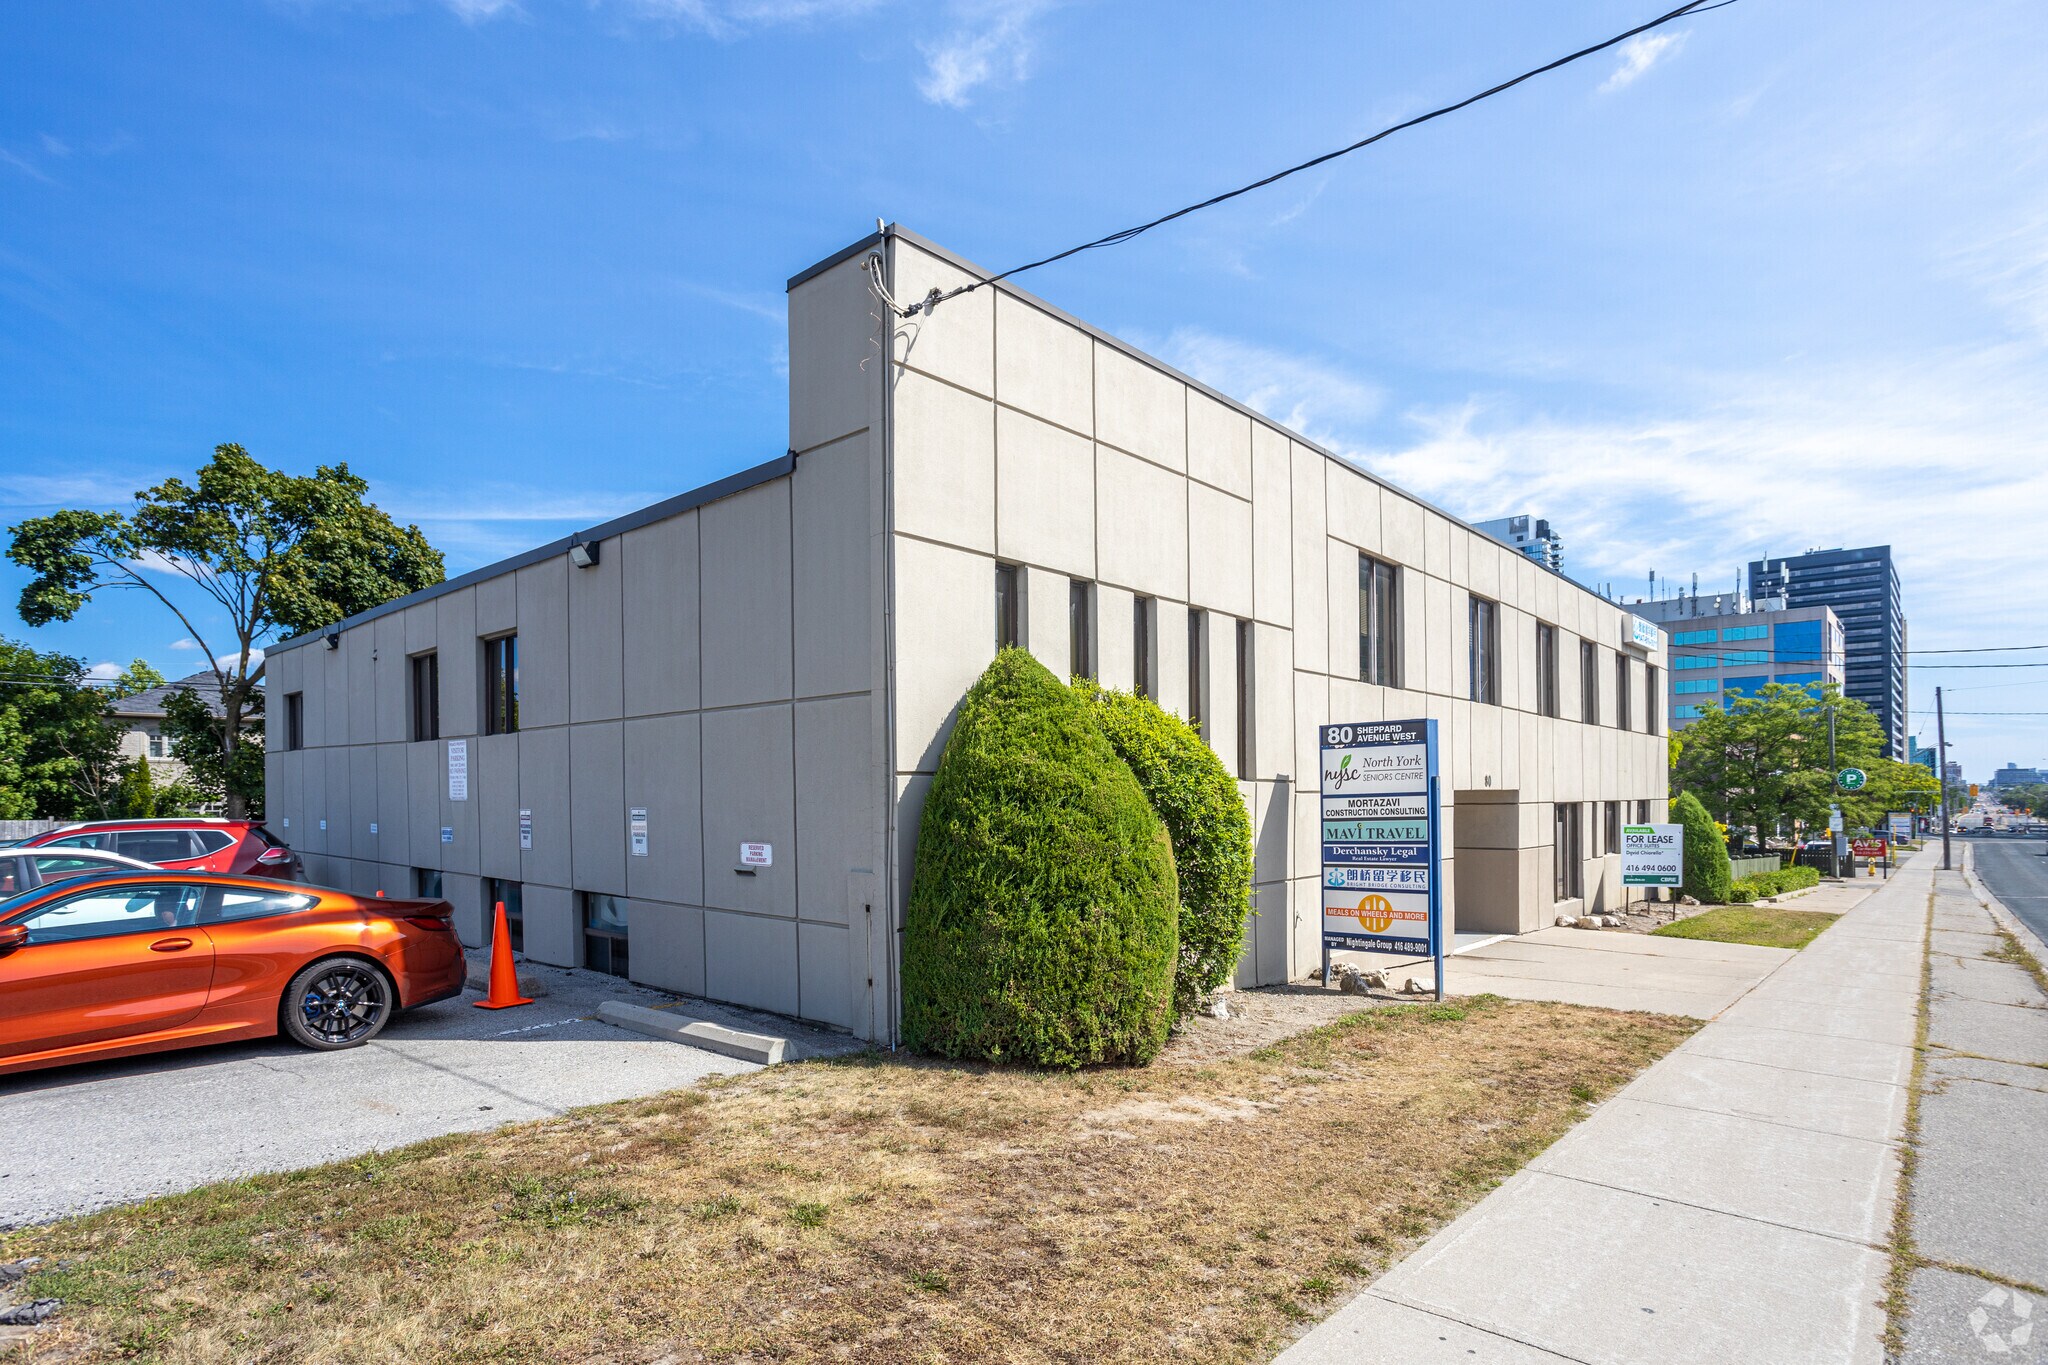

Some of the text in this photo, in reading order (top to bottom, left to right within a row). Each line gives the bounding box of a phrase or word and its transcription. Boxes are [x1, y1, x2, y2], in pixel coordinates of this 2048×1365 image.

[1357, 725, 1402, 734] SHEPPARD
[1328, 726, 1353, 744] 80
[1357, 732, 1416, 742] AVENUE WEST
[1362, 754, 1422, 768] North York
[1324, 768, 1360, 790] nysc
[1363, 772, 1424, 782] SENIORS CENTRE
[1846, 774, 1856, 784] P
[1348, 798, 1400, 808] MORTAZAVI
[1380, 807, 1426, 816] CONSULTING
[1366, 828, 1424, 839] TRAVEL
[1626, 835, 1644, 843] FOR
[1333, 847, 1417, 858] Derchansky Legal
[1347, 869, 1425, 883] 朗桥留学移民
[1361, 910, 1388, 918] WHEELS
[1346, 938, 1427, 953] Nightingale Group 416 489-9001
